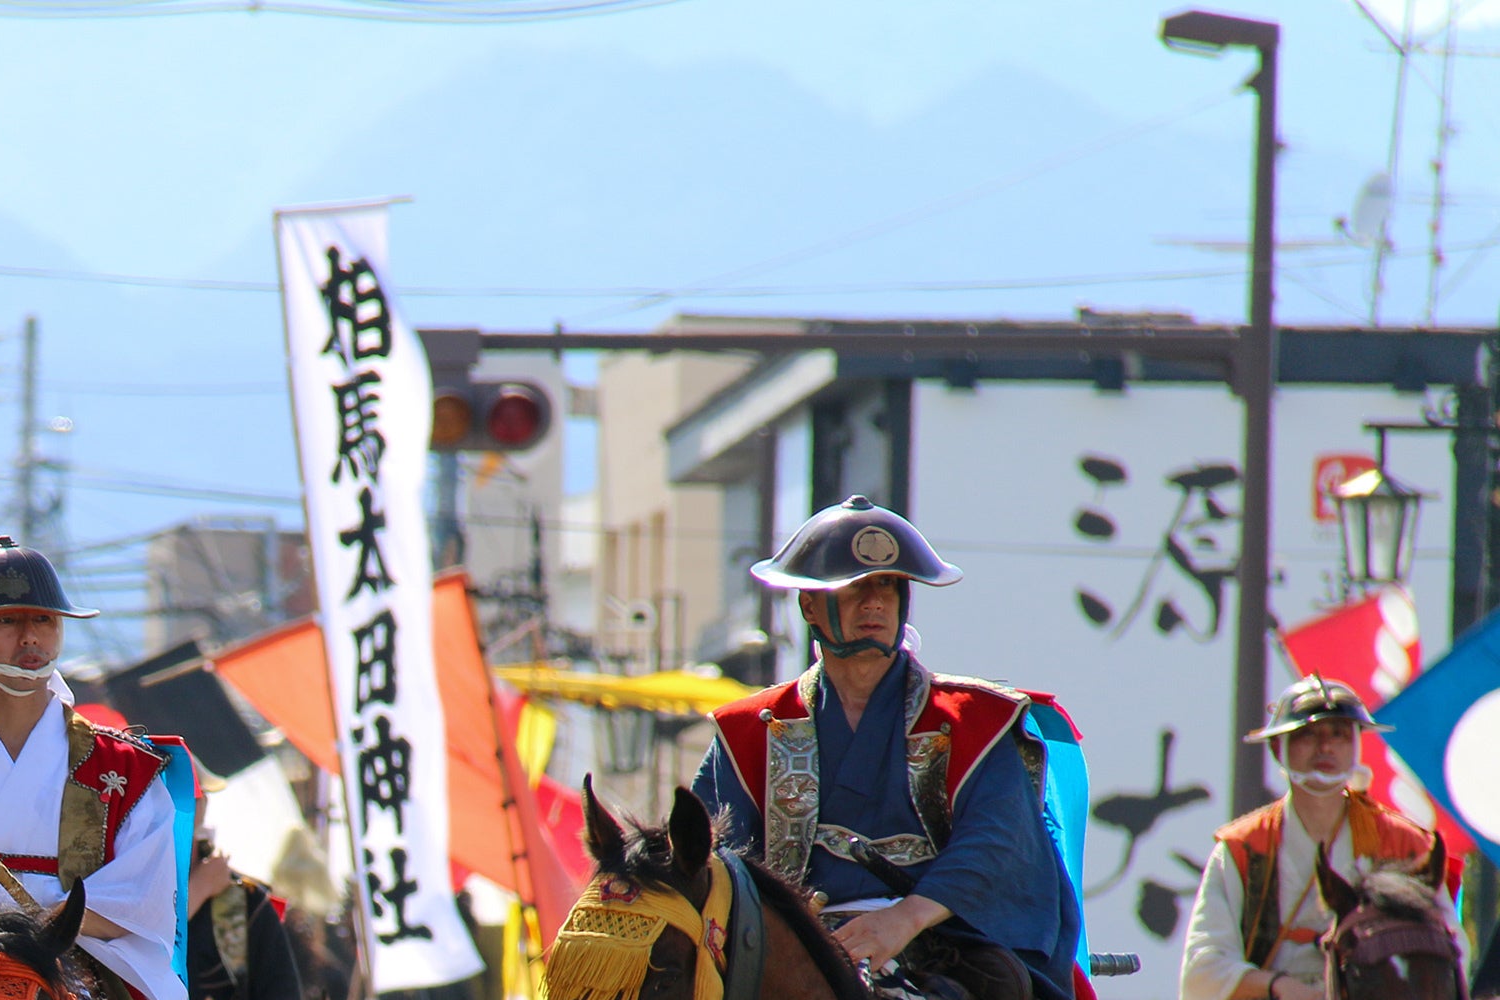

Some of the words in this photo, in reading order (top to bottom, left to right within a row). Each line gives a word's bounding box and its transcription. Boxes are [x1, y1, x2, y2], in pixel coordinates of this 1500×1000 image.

[320, 245, 433, 946] 相馬太田神社
